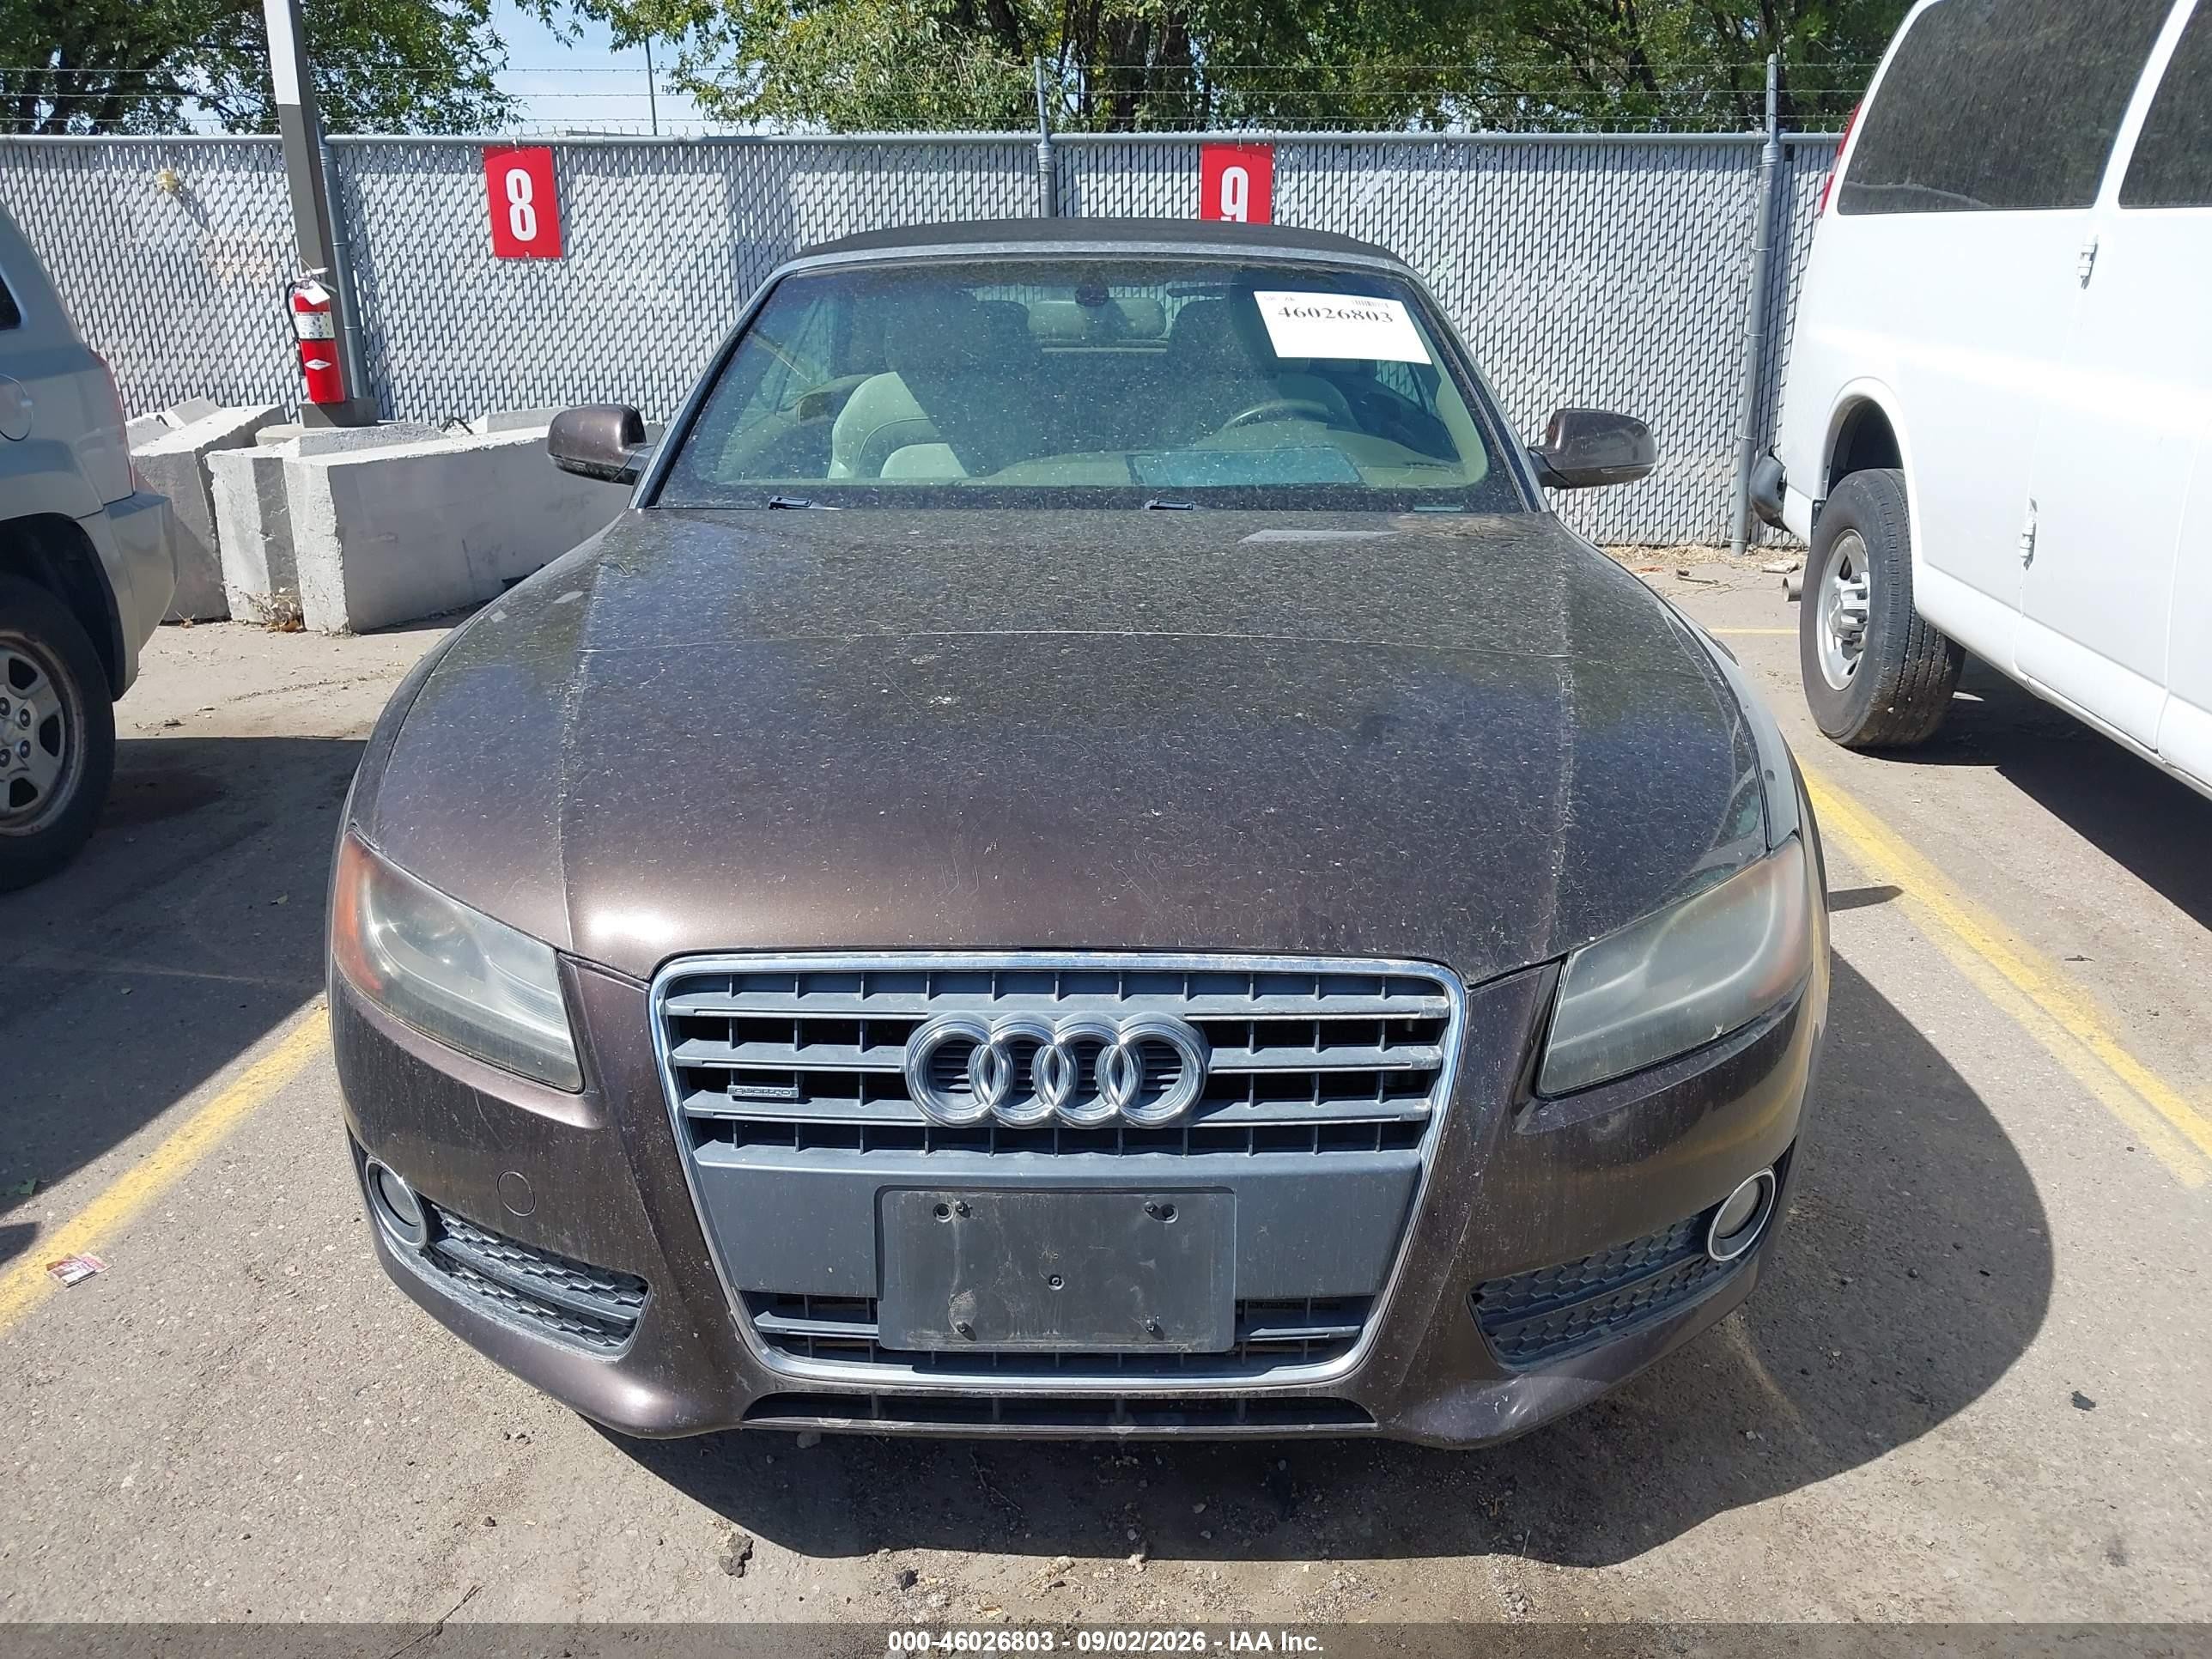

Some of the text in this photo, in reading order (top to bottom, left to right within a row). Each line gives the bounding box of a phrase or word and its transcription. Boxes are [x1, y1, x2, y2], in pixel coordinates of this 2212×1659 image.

[506, 168, 538, 241] 8
[1220, 166, 1249, 222] 9
[1277, 306, 1394, 324] 46026803
[733, 1087, 792, 1097] quattro
